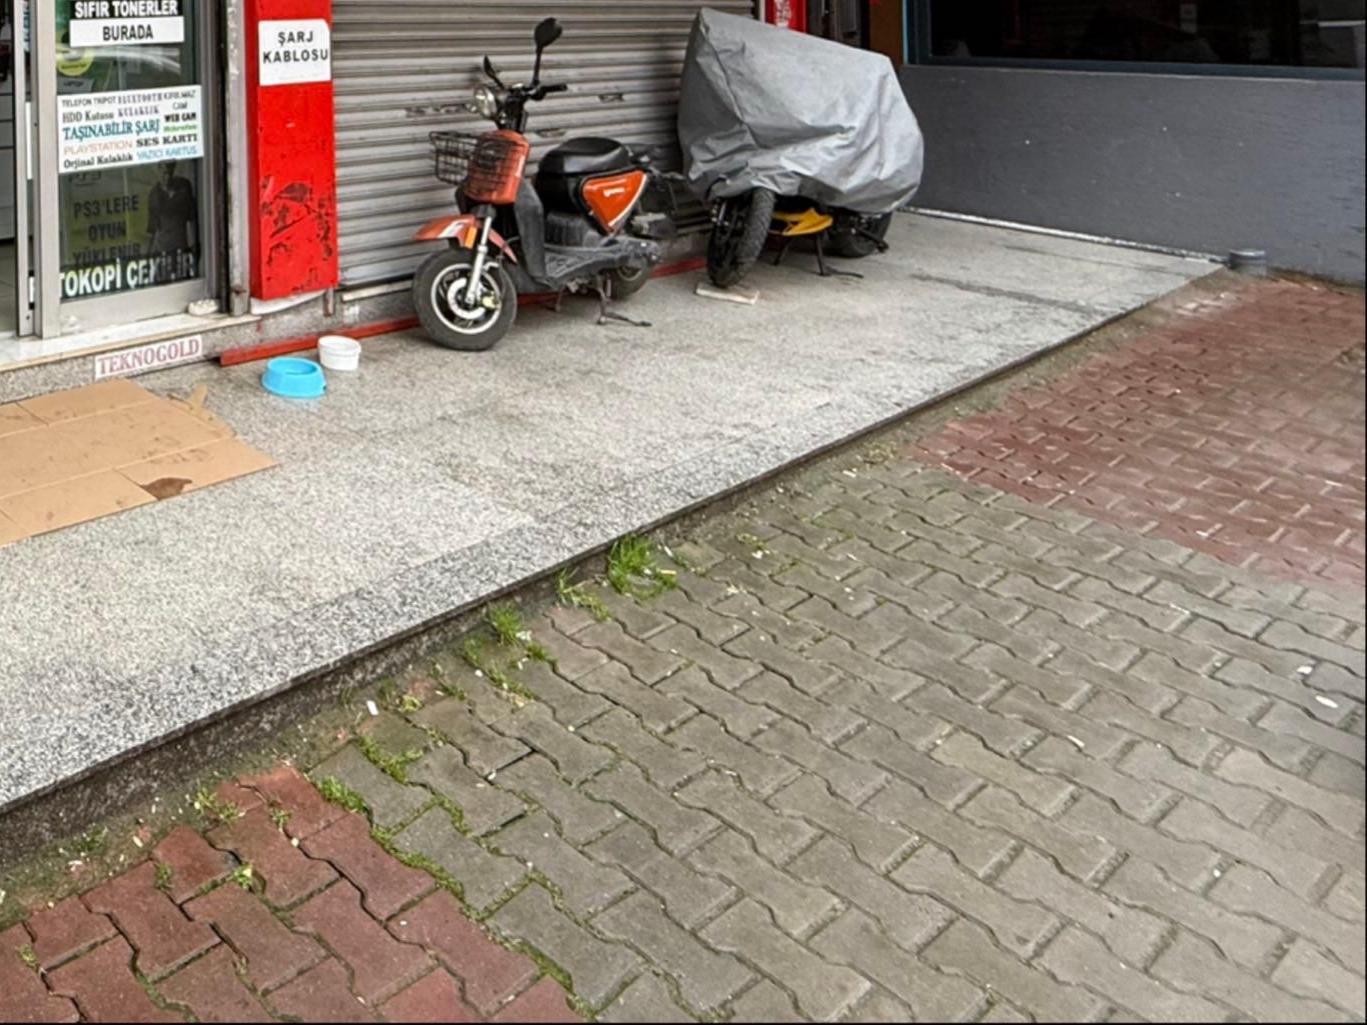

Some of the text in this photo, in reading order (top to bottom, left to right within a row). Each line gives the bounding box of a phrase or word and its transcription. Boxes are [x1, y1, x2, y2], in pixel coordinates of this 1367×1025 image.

[75, 0, 178, 18] SIFIR TONERLER
[102, 24, 154, 41] BURADA
[277, 31, 314, 45] ŞARJ
[262, 48, 329, 64] KABLOSU
[62, 98, 92, 108] TELEFON
[62, 112, 83, 123] HDD
[62, 118, 160, 143] TAŞINABİLİR ŞARJ
[64, 140, 132, 156] PLAYSTATION
[136, 133, 198, 148] SES KARTI
[64, 156, 95, 169] Orjinal
[89, 221, 126, 241] OYUN
[98, 339, 200, 375] TEKNOGOLD
